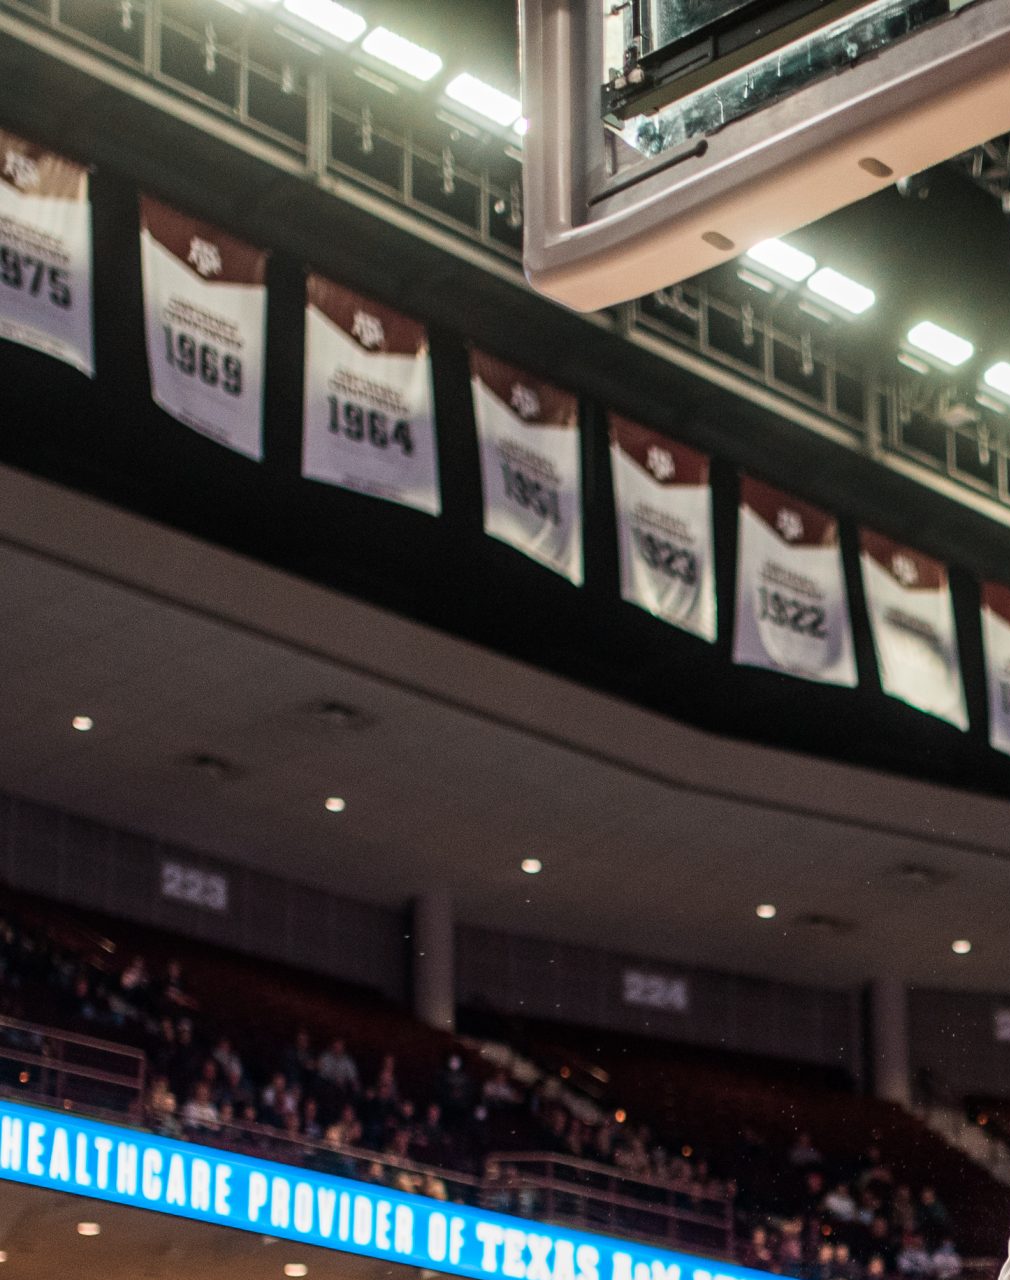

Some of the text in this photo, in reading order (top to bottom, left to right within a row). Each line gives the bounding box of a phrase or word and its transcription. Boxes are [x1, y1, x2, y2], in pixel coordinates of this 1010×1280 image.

[161, 322, 243, 399] 1969
[328, 394, 413, 458] 1964
[1, 1115, 232, 1216] HEALTHCARE
[248, 1171, 414, 1255] PROVIDER
[427, 1212, 465, 1265] OF
